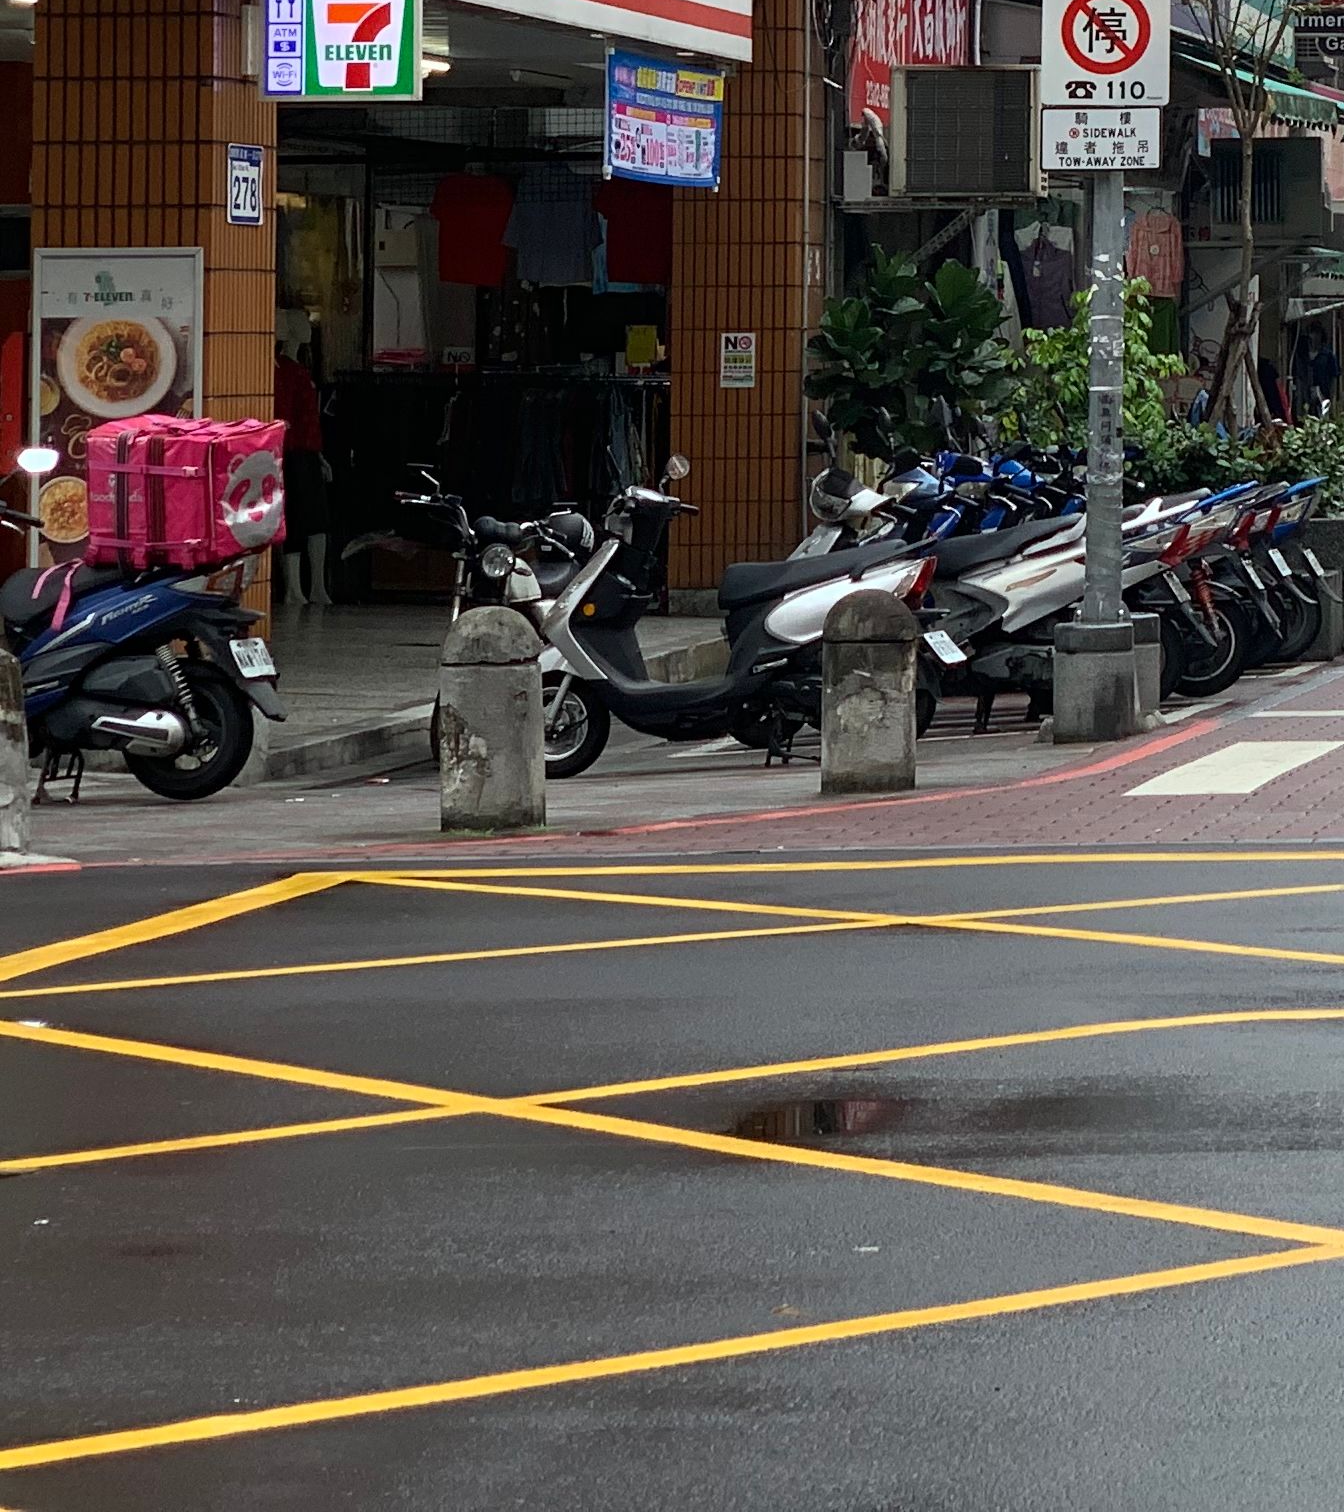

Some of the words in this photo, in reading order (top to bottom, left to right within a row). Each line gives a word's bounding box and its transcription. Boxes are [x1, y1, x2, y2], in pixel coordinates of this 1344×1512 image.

[273, 27, 298, 39] ATM
[1082, 6, 1128, 55] 停
[326, 0, 393, 90] 7
[1106, 80, 1146, 101] 110
[1082, 127, 1137, 139] SIDEWALK
[1120, 155, 1146, 167] ZONE
[232, 174, 258, 213] 278
